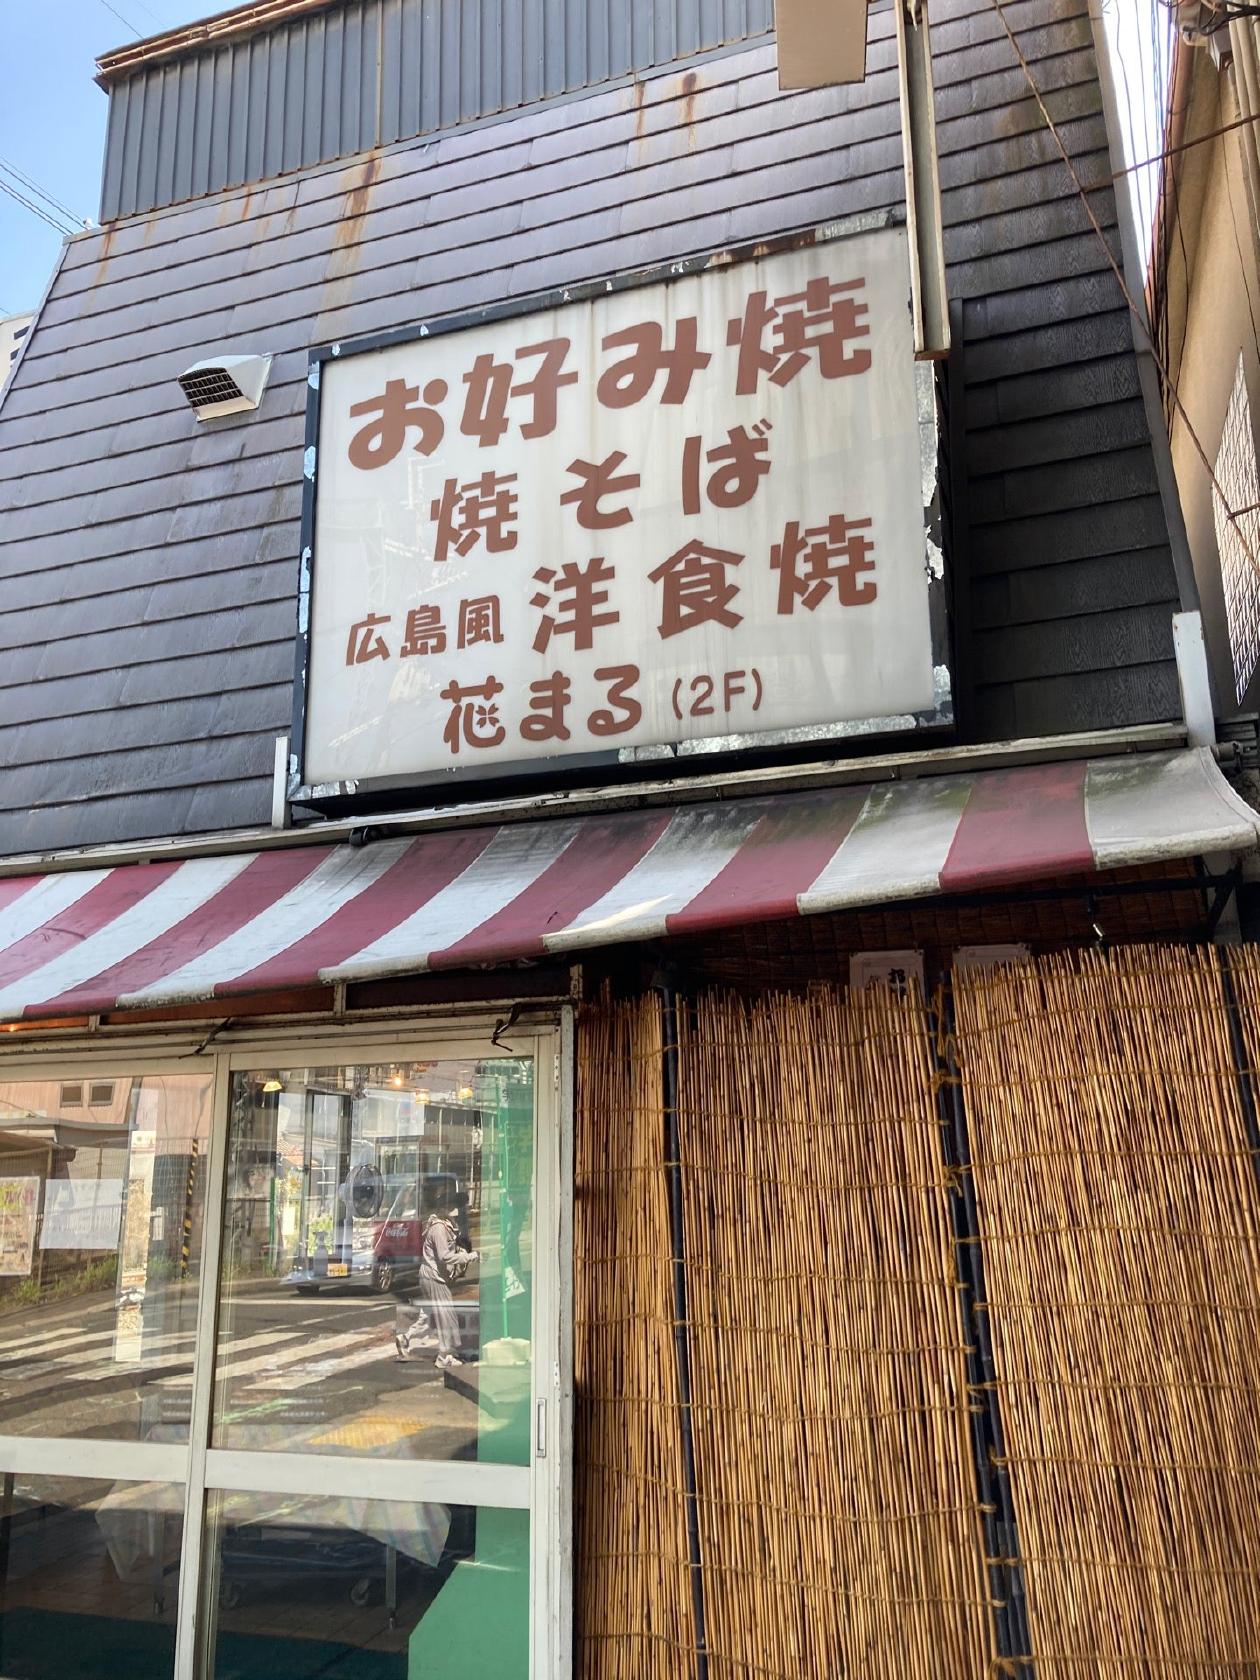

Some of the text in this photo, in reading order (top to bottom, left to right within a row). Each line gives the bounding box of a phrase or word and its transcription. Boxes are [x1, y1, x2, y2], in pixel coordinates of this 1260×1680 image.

[348, 277, 873, 470] お好み焼
[430, 418, 773, 561] 焼そば
[346, 513, 877, 665] 広島風 洋食焼
[440, 664, 763, 753] 花まる (2F)
